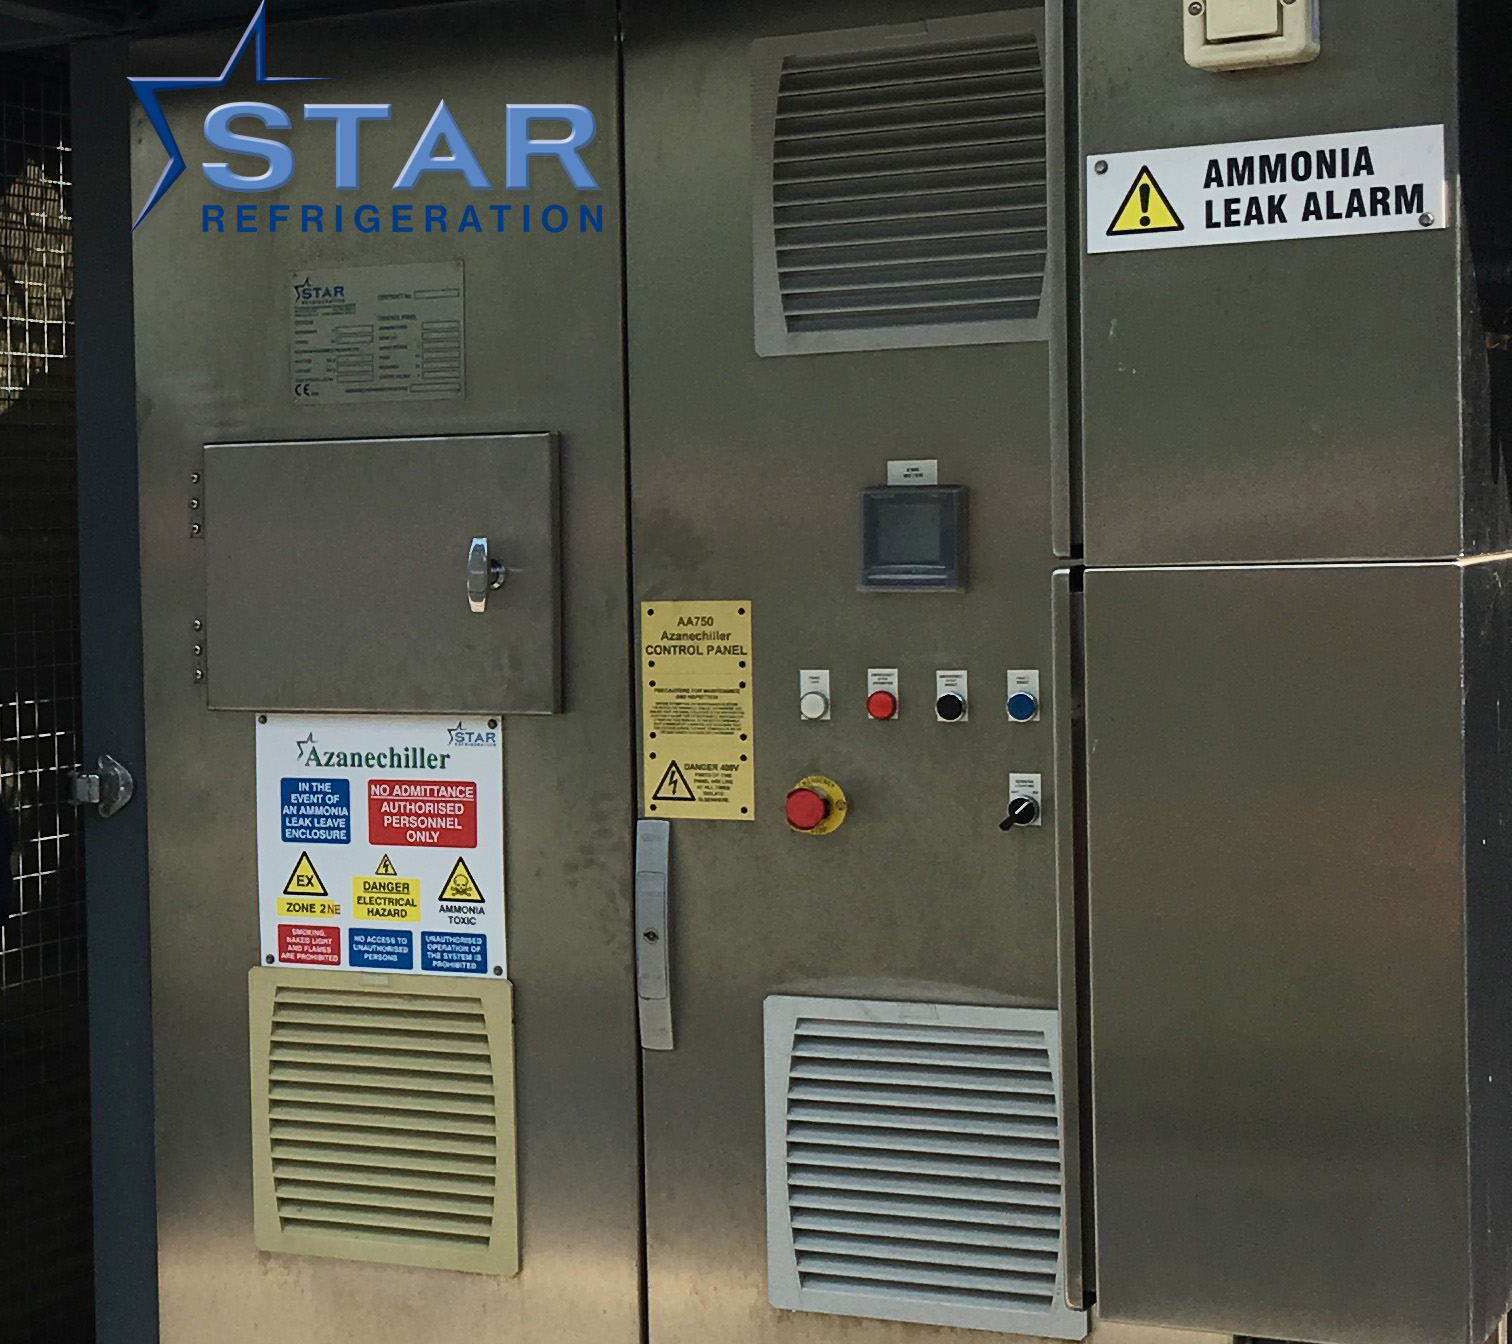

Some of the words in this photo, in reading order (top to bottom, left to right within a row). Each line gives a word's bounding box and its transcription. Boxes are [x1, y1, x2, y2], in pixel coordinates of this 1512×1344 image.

[1203, 145, 1375, 189] AMMONIA
[1205, 194, 1288, 229] LEAK
[1302, 183, 1424, 222] ALARM
[302, 286, 345, 299] STAR
[295, 384, 310, 397] CE
[677, 616, 714, 627] AA750
[661, 630, 731, 641] Azanechiller
[645, 644, 703, 656] CONTROL
[707, 645, 747, 655] PANEL
[454, 731, 496, 743] STAR
[304, 746, 450, 769] Azanechiller
[684, 763, 718, 771] DANGER
[298, 782, 309, 792] IN
[311, 782, 332, 792] THE
[370, 784, 390, 796] NO
[392, 785, 474, 798] ADMITTANCE
[290, 793, 323, 803] EVENT
[325, 794, 340, 804] OF
[282, 805, 297, 815] AN
[299, 805, 348, 816] AMMONIA
[380, 801, 464, 815] AUTHORISED
[285, 817, 312, 827] LEAK
[314, 818, 346, 828] LEAVE
[383, 816, 463, 830] PERSONNEL
[285, 829, 347, 840] ENCLOSURE
[406, 830, 440, 842] ONLY
[296, 875, 314, 887] EX
[363, 881, 410, 892] DANGER
[357, 896, 417, 907] ELECTRICAL
[286, 902, 316, 913] ZONE
[320, 904, 326, 913] 2
[367, 908, 407, 918] HAZARD
[439, 905, 485, 915] AMMONIA
[448, 916, 477, 925] TOXIC
[286, 936, 310, 944] NAKED
[354, 935, 365, 943] NO
[366, 936, 396, 944] ACCESS
[425, 935, 482, 945] UNAUTHORISED
[287, 944, 302, 952] AND
[304, 945, 332, 953] FLAMES
[352, 944, 409, 953] UNAUTHORISED
[427, 943, 469, 952] OPERATION
[280, 952, 295, 960] ARE
[296, 953, 338, 962] PROHIBITED
[363, 953, 398, 962] PERSONS
[443, 952, 472, 961] SYSTEM
[432, 960, 477, 970] PROHIBITED
